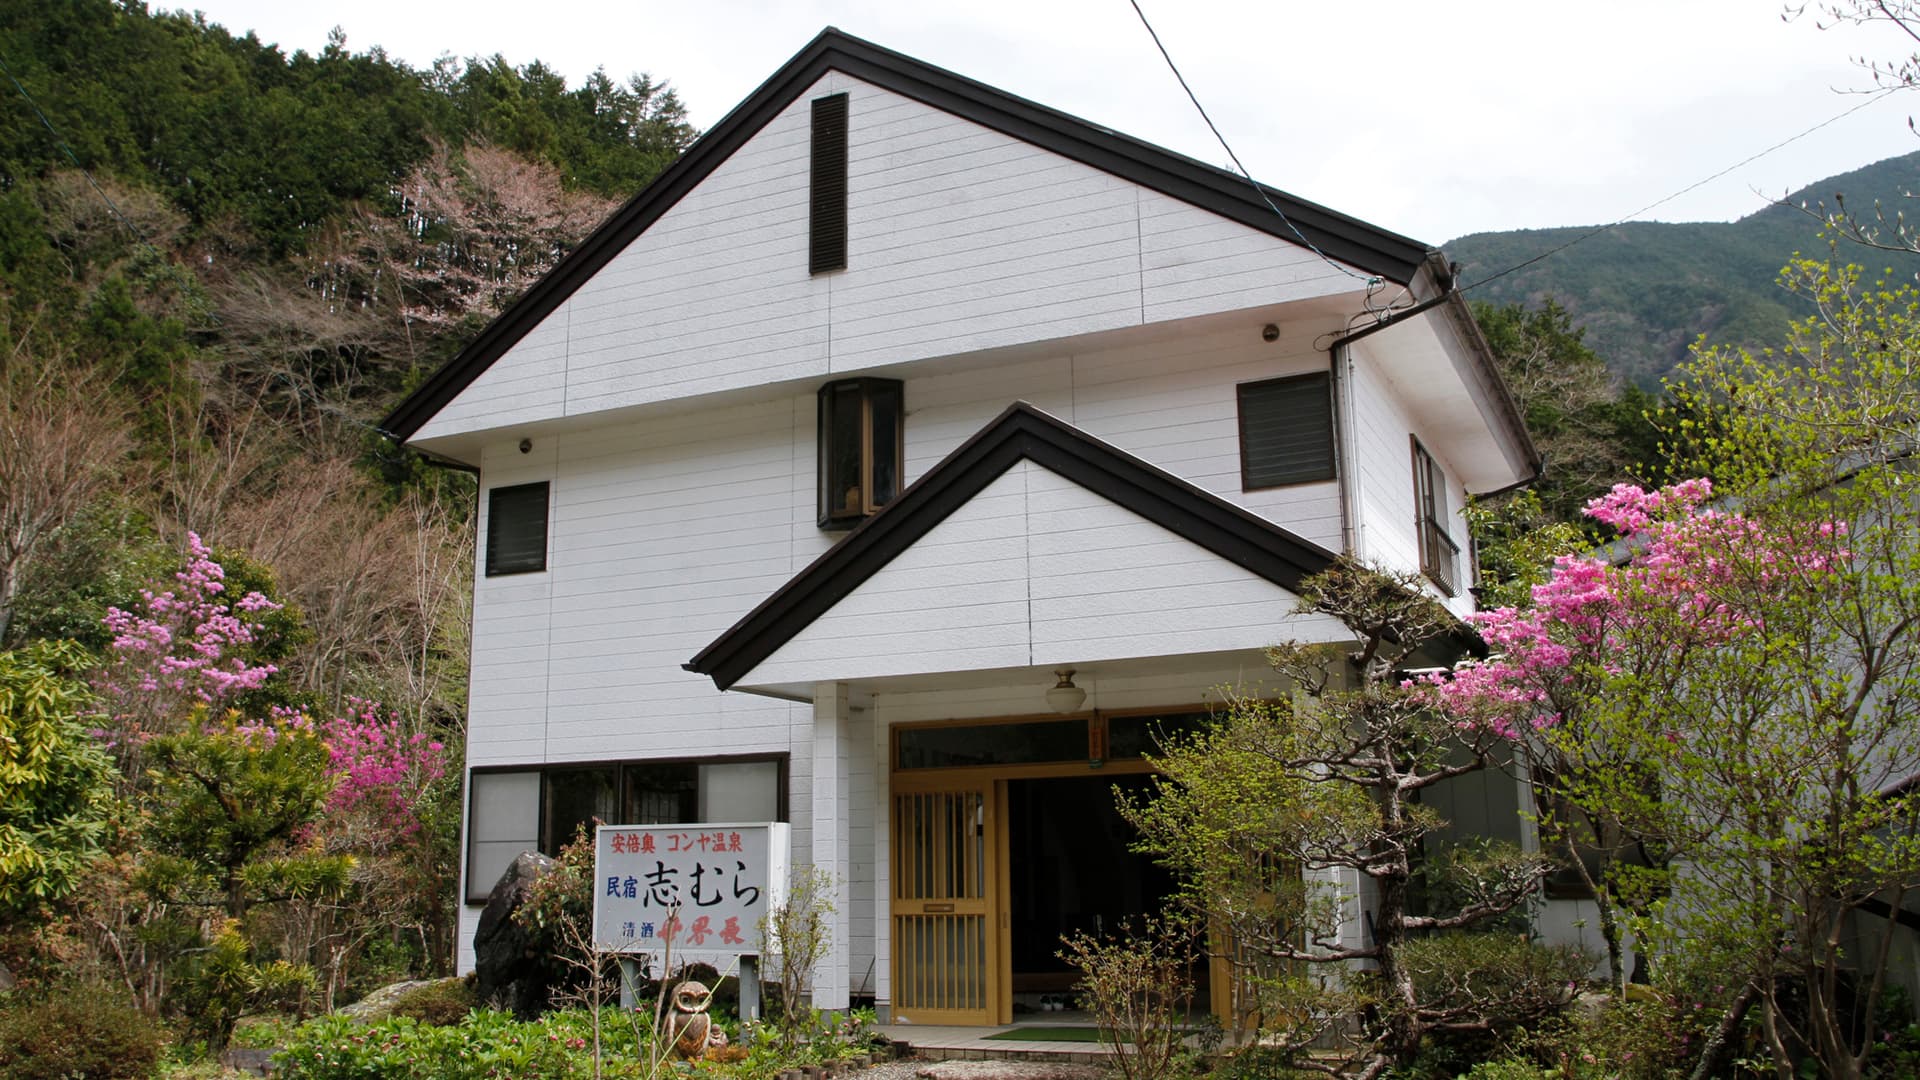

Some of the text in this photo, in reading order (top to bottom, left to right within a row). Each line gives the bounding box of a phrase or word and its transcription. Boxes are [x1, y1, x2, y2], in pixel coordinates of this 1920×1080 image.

[610, 831, 743, 854] 安倍奥 コンヤ温泉
[606, 860, 760, 908] 民宿 志むら
[622, 921, 655, 938] 清酒
